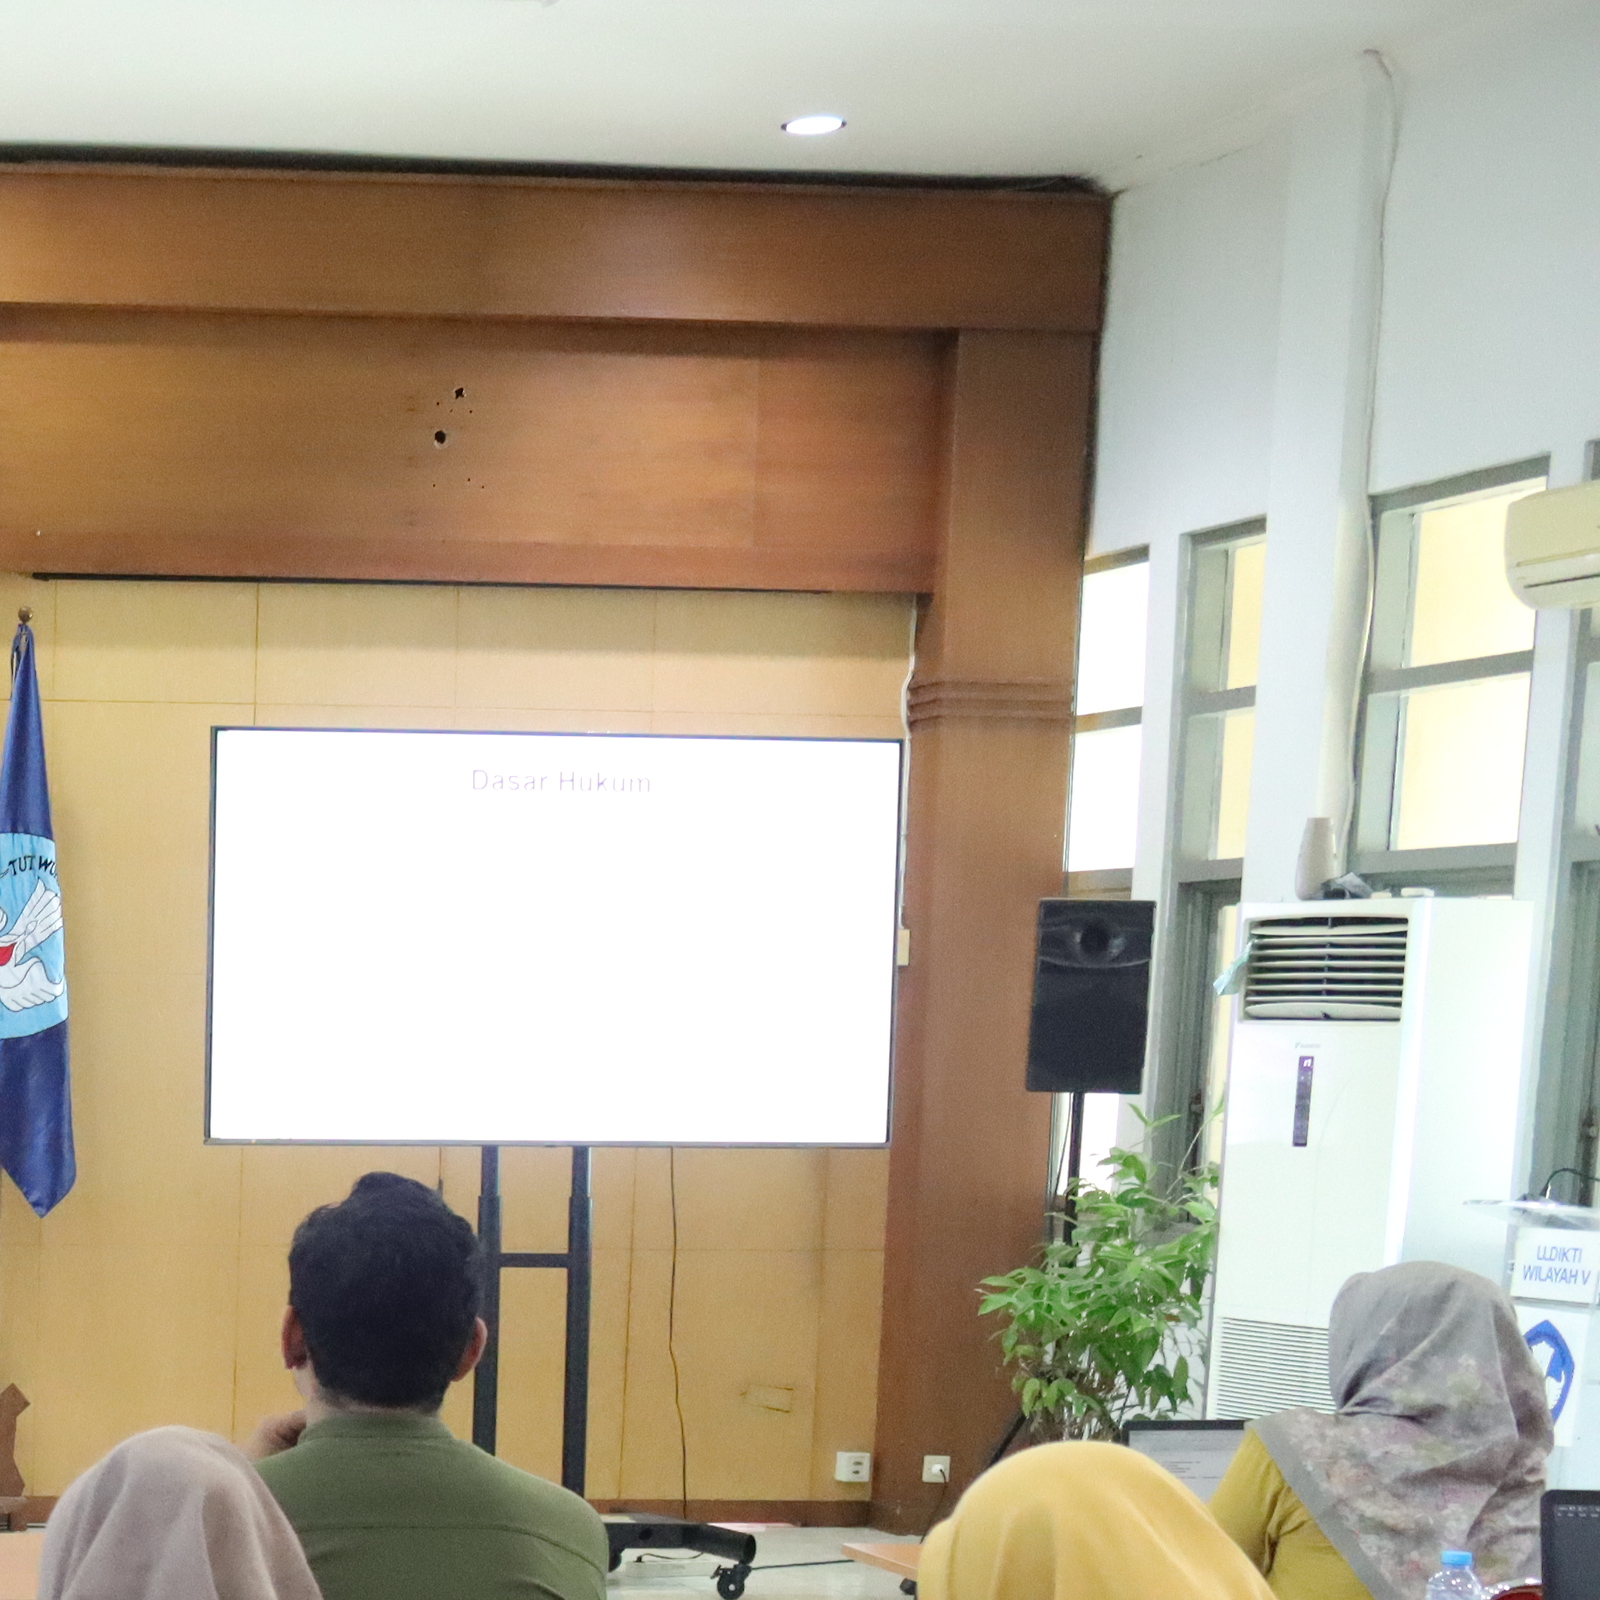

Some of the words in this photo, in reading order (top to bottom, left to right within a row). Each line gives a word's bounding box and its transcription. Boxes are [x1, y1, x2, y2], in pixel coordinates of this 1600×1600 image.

[472, 769, 548, 791] Dasar
[559, 771, 651, 793] Hukum
[8, 855, 36, 876] TUT
[1536, 1245, 1583, 1263] LLDIKTI
[1523, 1264, 1579, 1284] WILAYAH
[1582, 1270, 1592, 1286] V
